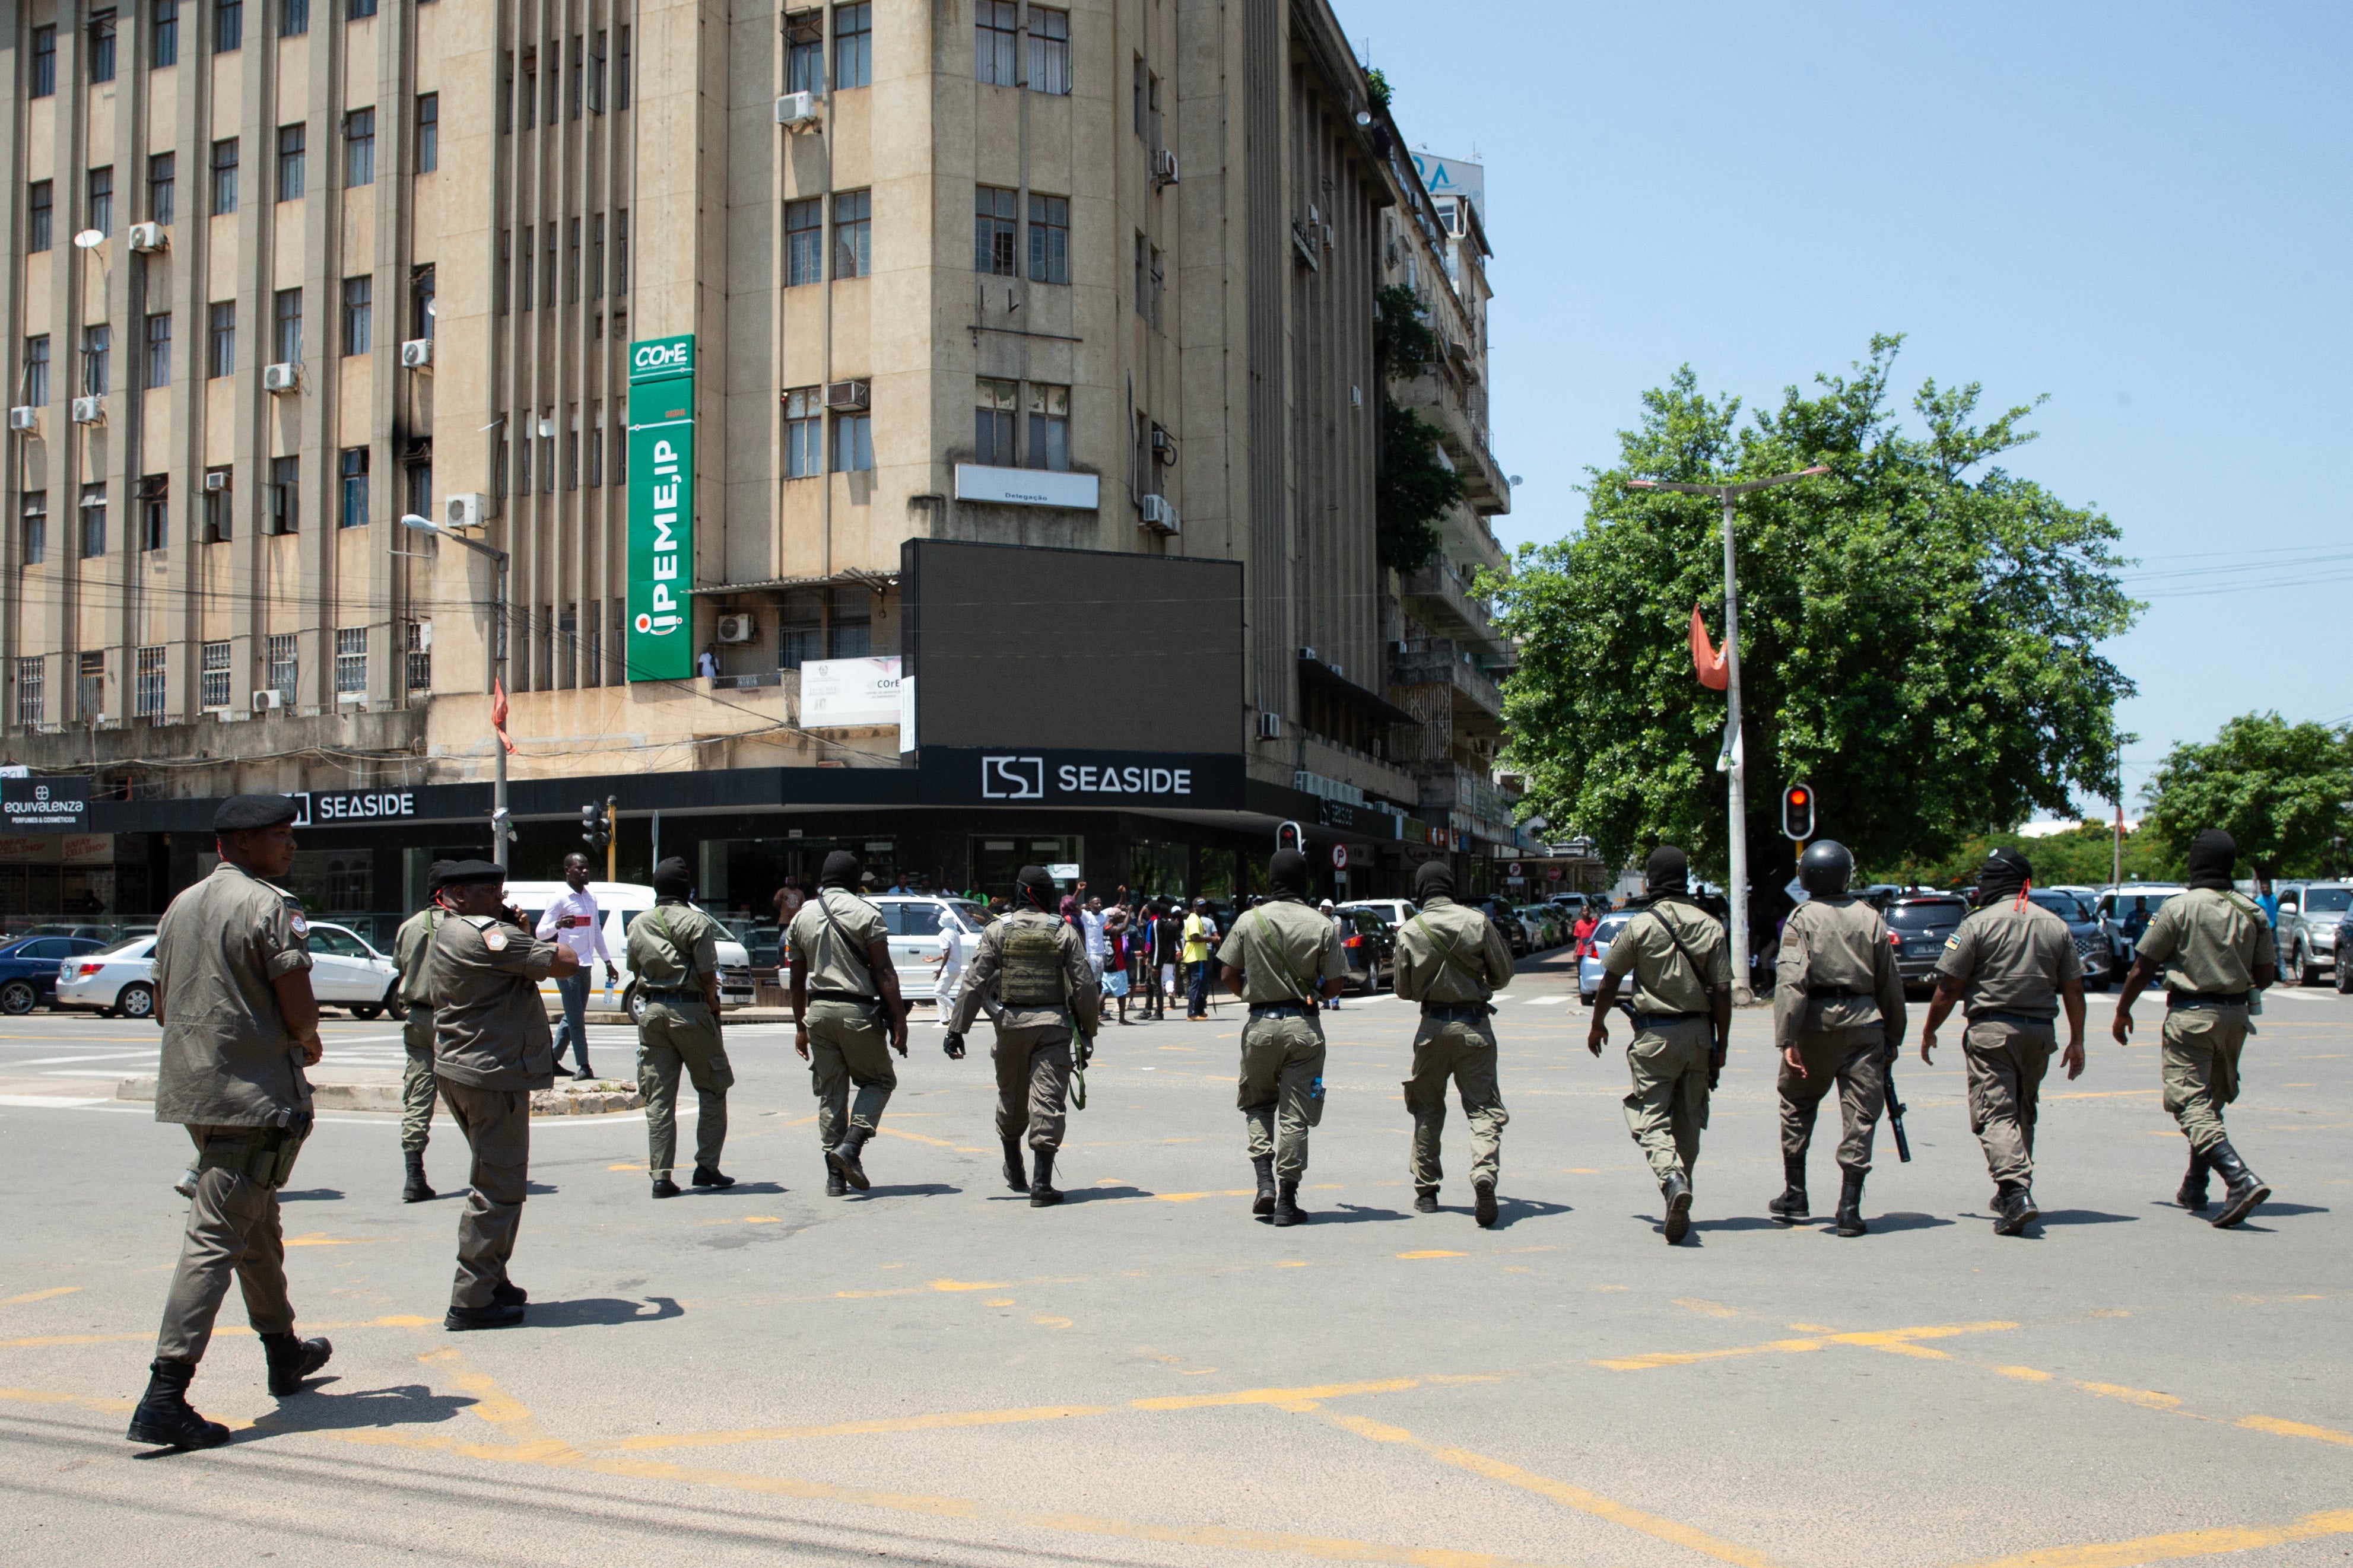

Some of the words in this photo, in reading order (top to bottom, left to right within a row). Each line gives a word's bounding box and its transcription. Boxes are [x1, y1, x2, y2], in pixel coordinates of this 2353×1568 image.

[665, 409, 685, 418] SEDE
[1005, 492, 1048, 501] Delegação
[1059, 765, 1191, 793] SEASIDE
[320, 793, 414, 818] SEASIDE
